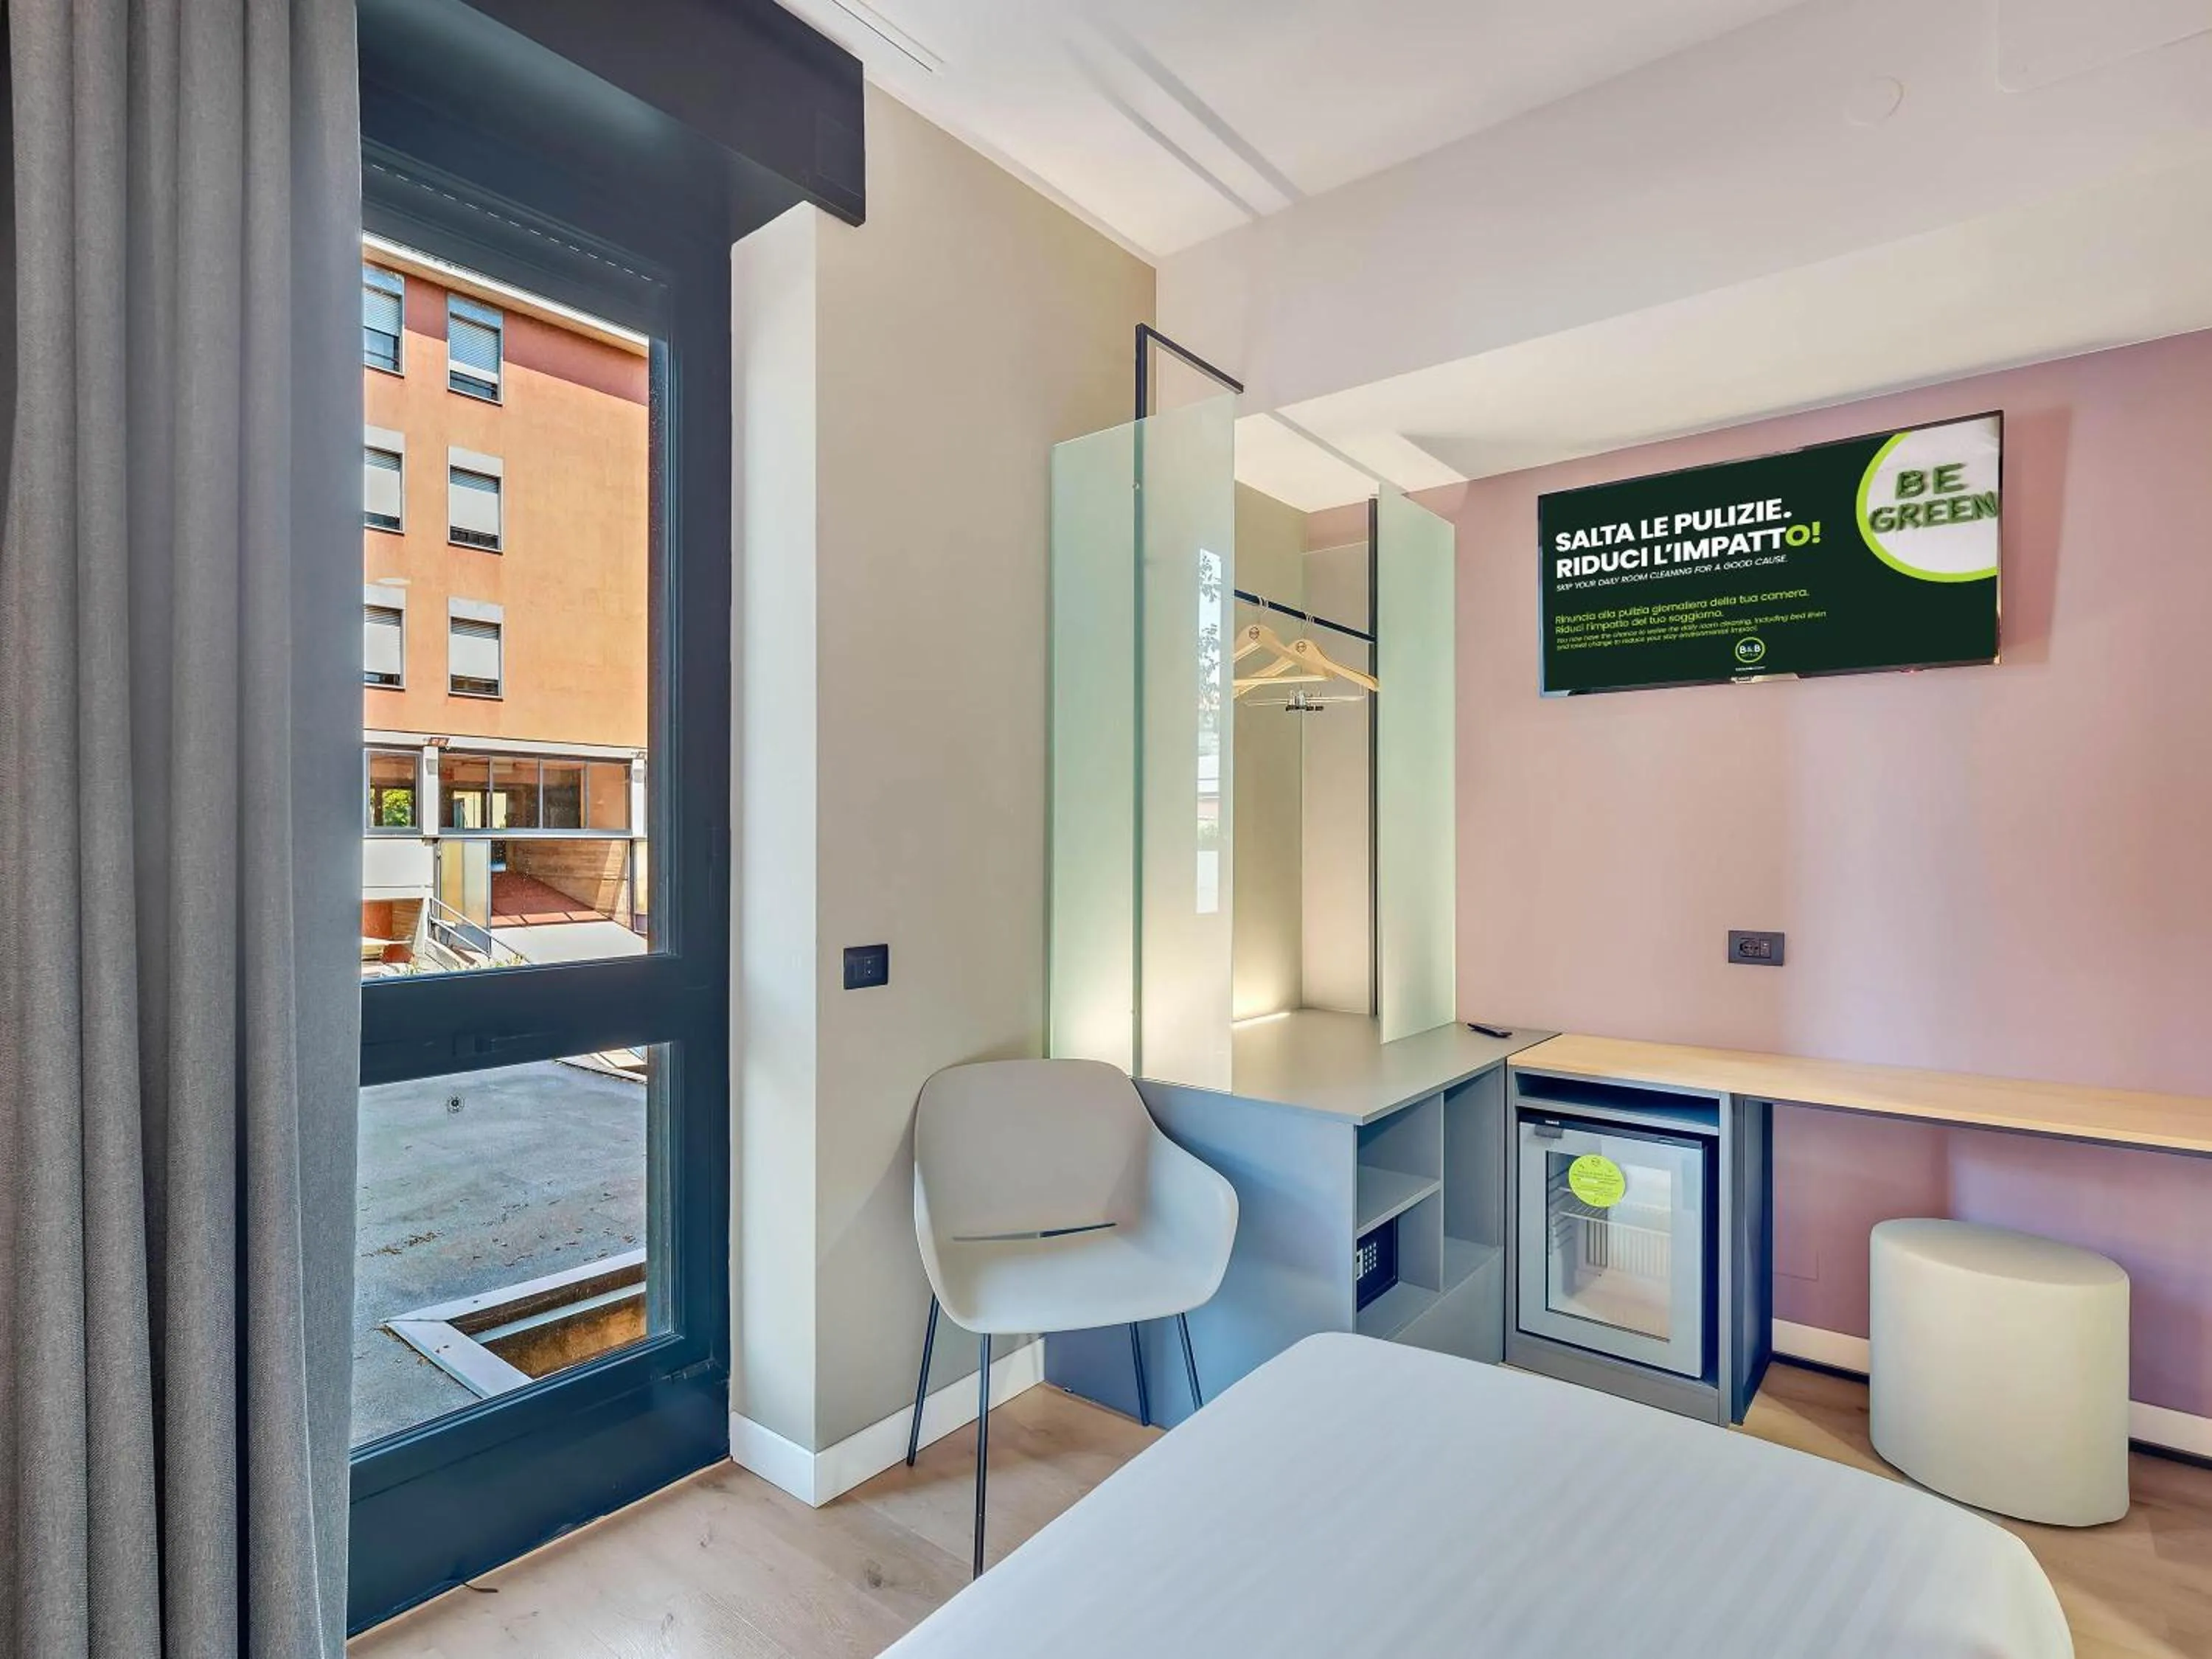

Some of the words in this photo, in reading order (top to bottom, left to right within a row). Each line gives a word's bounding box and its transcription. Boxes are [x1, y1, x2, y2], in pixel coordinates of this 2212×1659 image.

[1896, 462, 1968, 499] BE
[1556, 523, 1635, 552] SALTA
[1641, 516, 1669, 540] LE
[1674, 498, 1792, 535] PULIZIE.
[1870, 491, 1997, 533] GREEN
[1557, 547, 1648, 579] RIDUCI
[1654, 521, 1820, 566] L'IMPATTO!
[1557, 582, 1573, 591] SKIP
[1575, 580, 1596, 589] YOUR
[1598, 577, 1619, 586] DAILY
[1621, 573, 1648, 582] ROOM
[1649, 567, 1692, 580] CLEANING
[1694, 564, 1713, 574] FOR
[1723, 560, 1753, 570] GOOD
[1755, 554, 1788, 566] CAUSE.
[1555, 613, 1596, 625] Rinuncia
[1598, 610, 1616, 619] alla
[1618, 606, 1649, 619] pulizia
[1651, 601, 1707, 616] giornaliera
[1710, 597, 1736, 607] della
[1739, 594, 1758, 603] tua
[1760, 589, 1809, 601] camera.
[1555, 623, 1585, 634] Riduci
[1631, 617, 1647, 626] del
[1649, 615, 1666, 624] tuo
[1739, 644, 1761, 654] B&B
